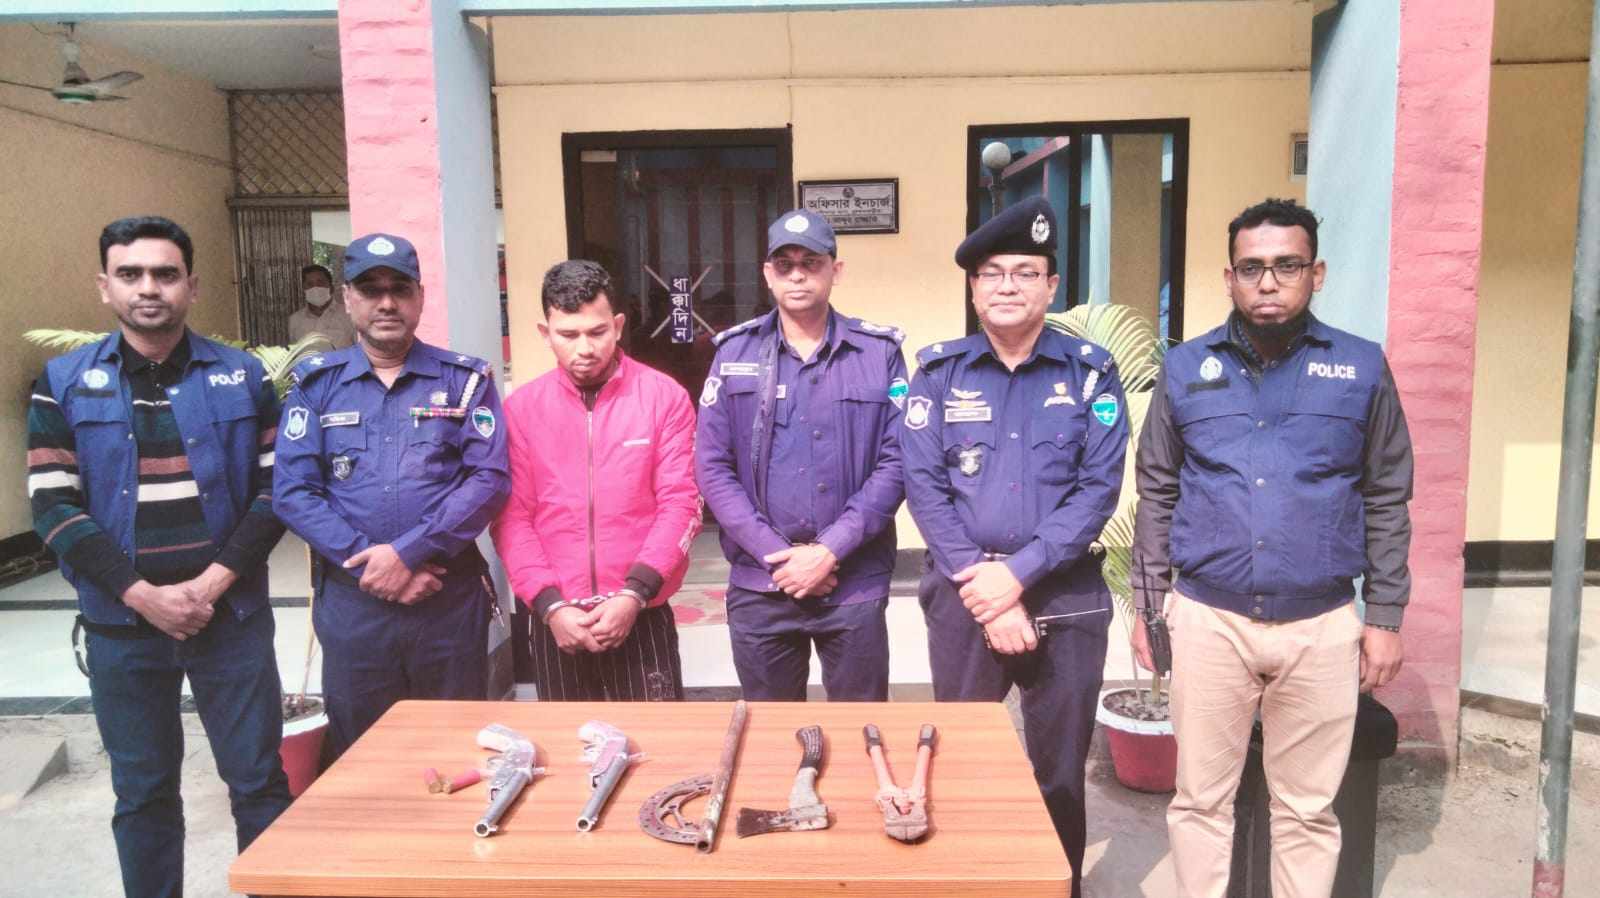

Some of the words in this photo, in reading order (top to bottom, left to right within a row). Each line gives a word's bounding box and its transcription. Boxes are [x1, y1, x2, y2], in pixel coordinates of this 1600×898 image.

[807, 196, 850, 209] অফিসার
[854, 195, 890, 208] ইনচার্জ
[670, 278, 690, 307] ধাক্কা
[671, 308, 689, 341] দিন
[208, 369, 247, 387] POLIC
[1308, 362, 1356, 379] POLICE
